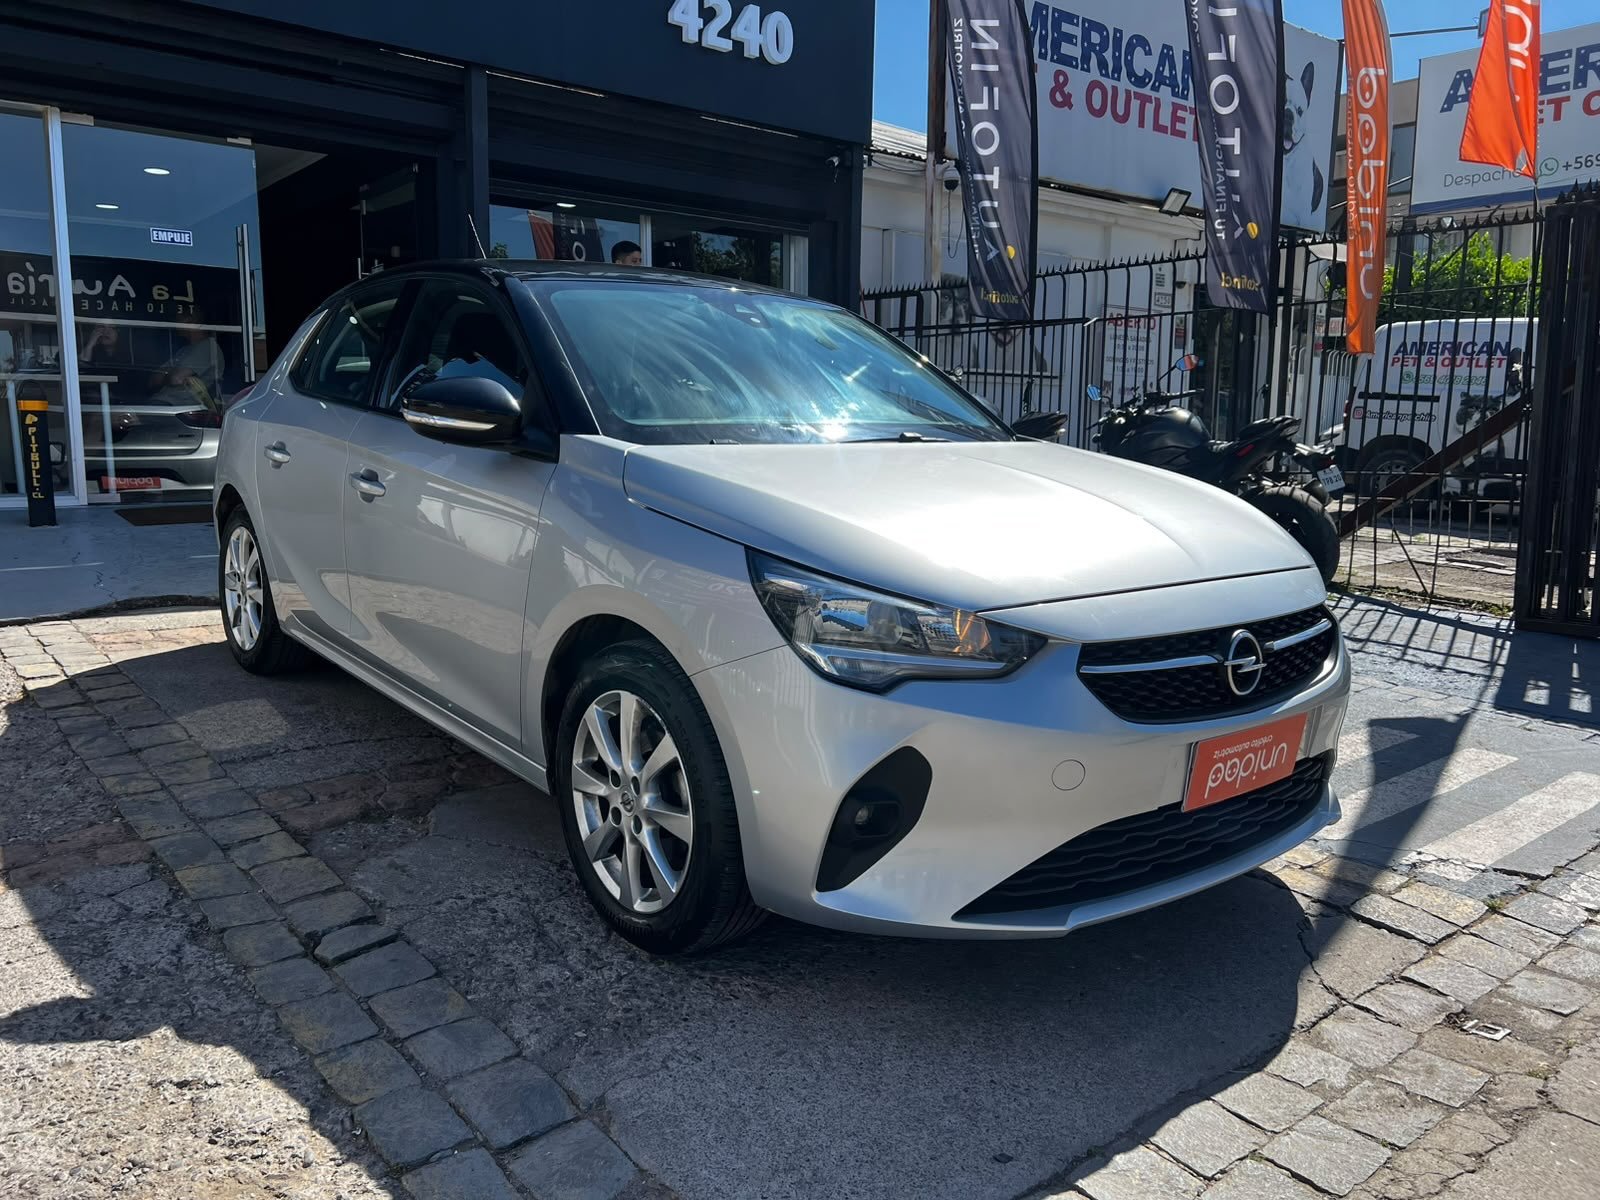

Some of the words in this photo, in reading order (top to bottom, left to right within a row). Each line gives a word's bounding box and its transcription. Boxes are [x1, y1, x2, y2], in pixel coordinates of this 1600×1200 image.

[667, 0, 794, 65] 4240
[1030, 1, 1193, 101] MERICA
[1049, 69, 1073, 111] &
[152, 229, 192, 245] EMPUJE
[1107, 312, 1156, 330] ABERTO
[1391, 357, 1419, 368] PET
[1441, 357, 1506, 369] OUTLET
[1394, 341, 1510, 356] AMERICAN
[1204, 742, 1287, 799] unidad
